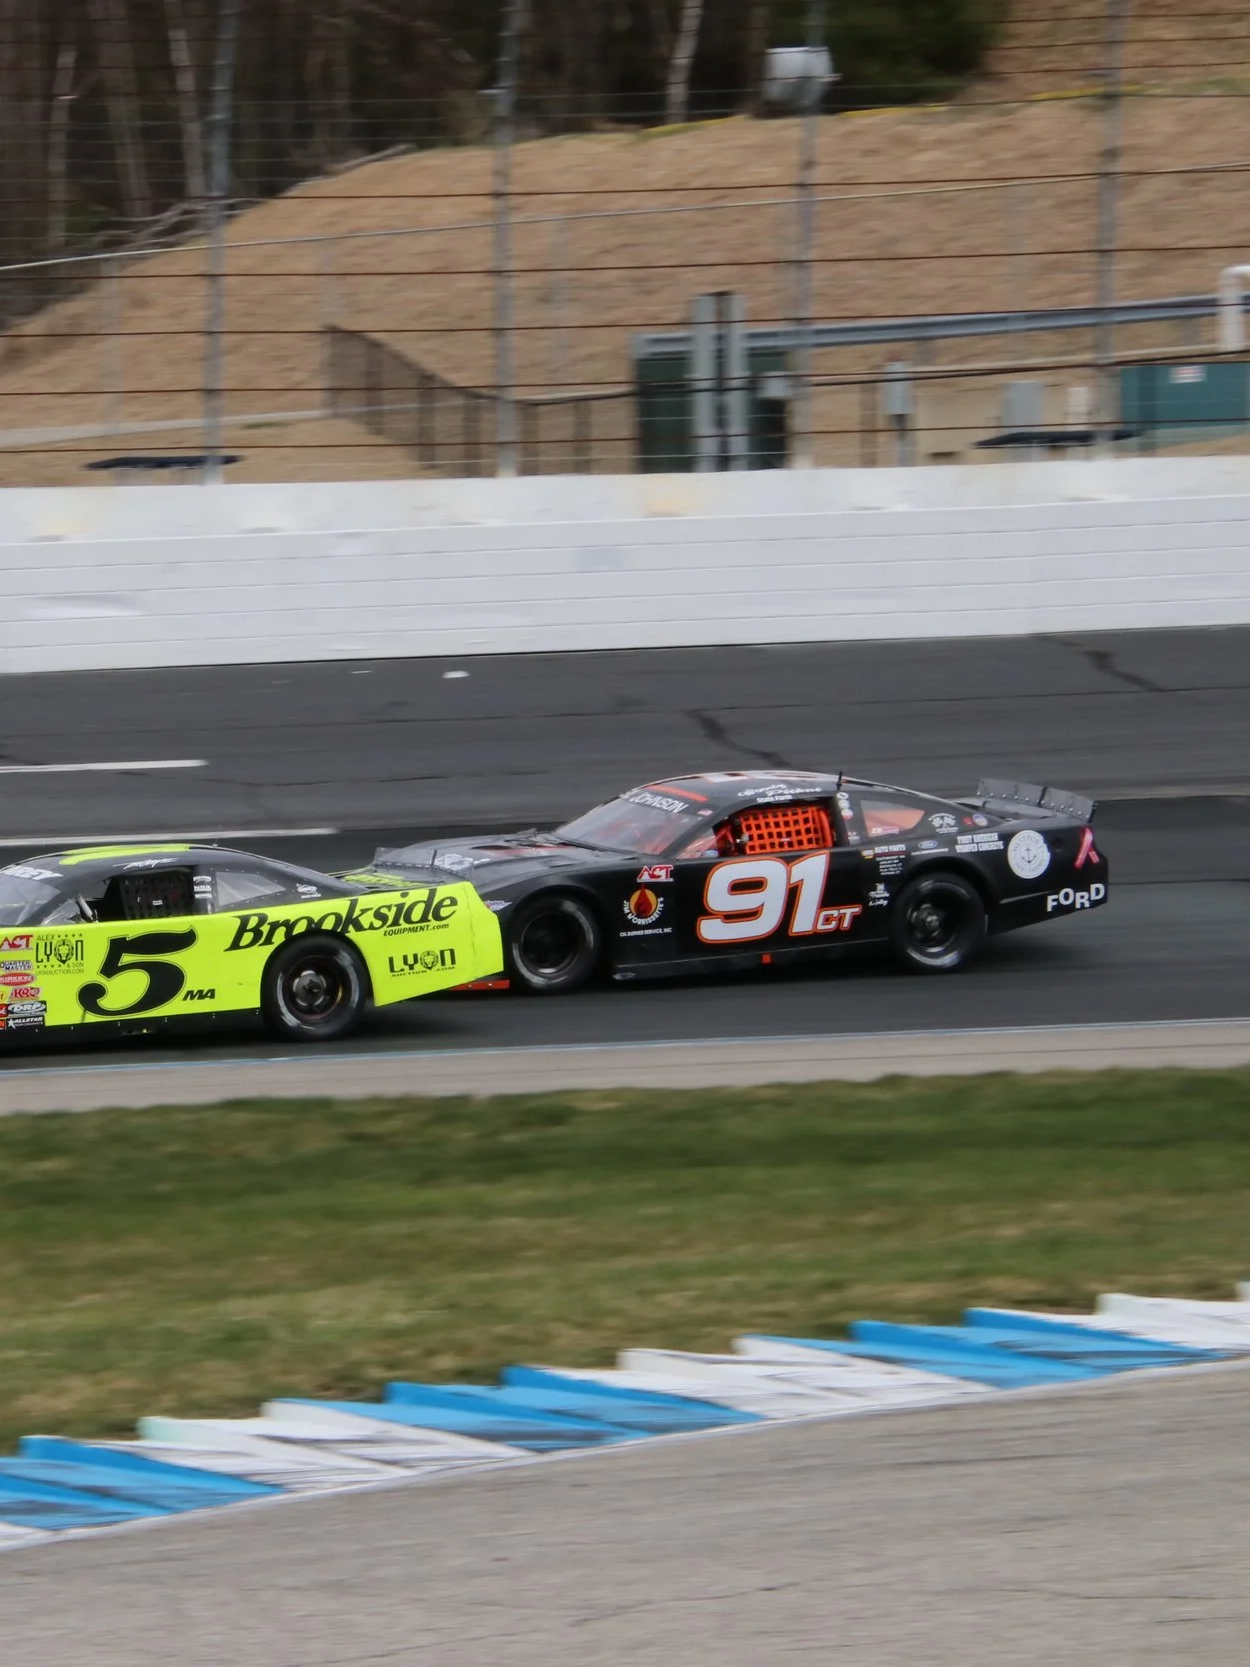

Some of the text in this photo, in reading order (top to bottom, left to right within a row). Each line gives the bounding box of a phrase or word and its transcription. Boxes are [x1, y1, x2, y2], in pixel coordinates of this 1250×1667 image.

[630, 791, 689, 813] JOHNSON
[637, 864, 674, 882] ACT
[696, 851, 831, 944] 91
[1046, 883, 1106, 913] FORD
[223, 887, 458, 952] Brookside
[383, 923, 450, 937] EQUIPMENT.com
[815, 904, 862, 932] CT
[76, 925, 198, 1018] 5
[182, 988, 216, 1001] MA
